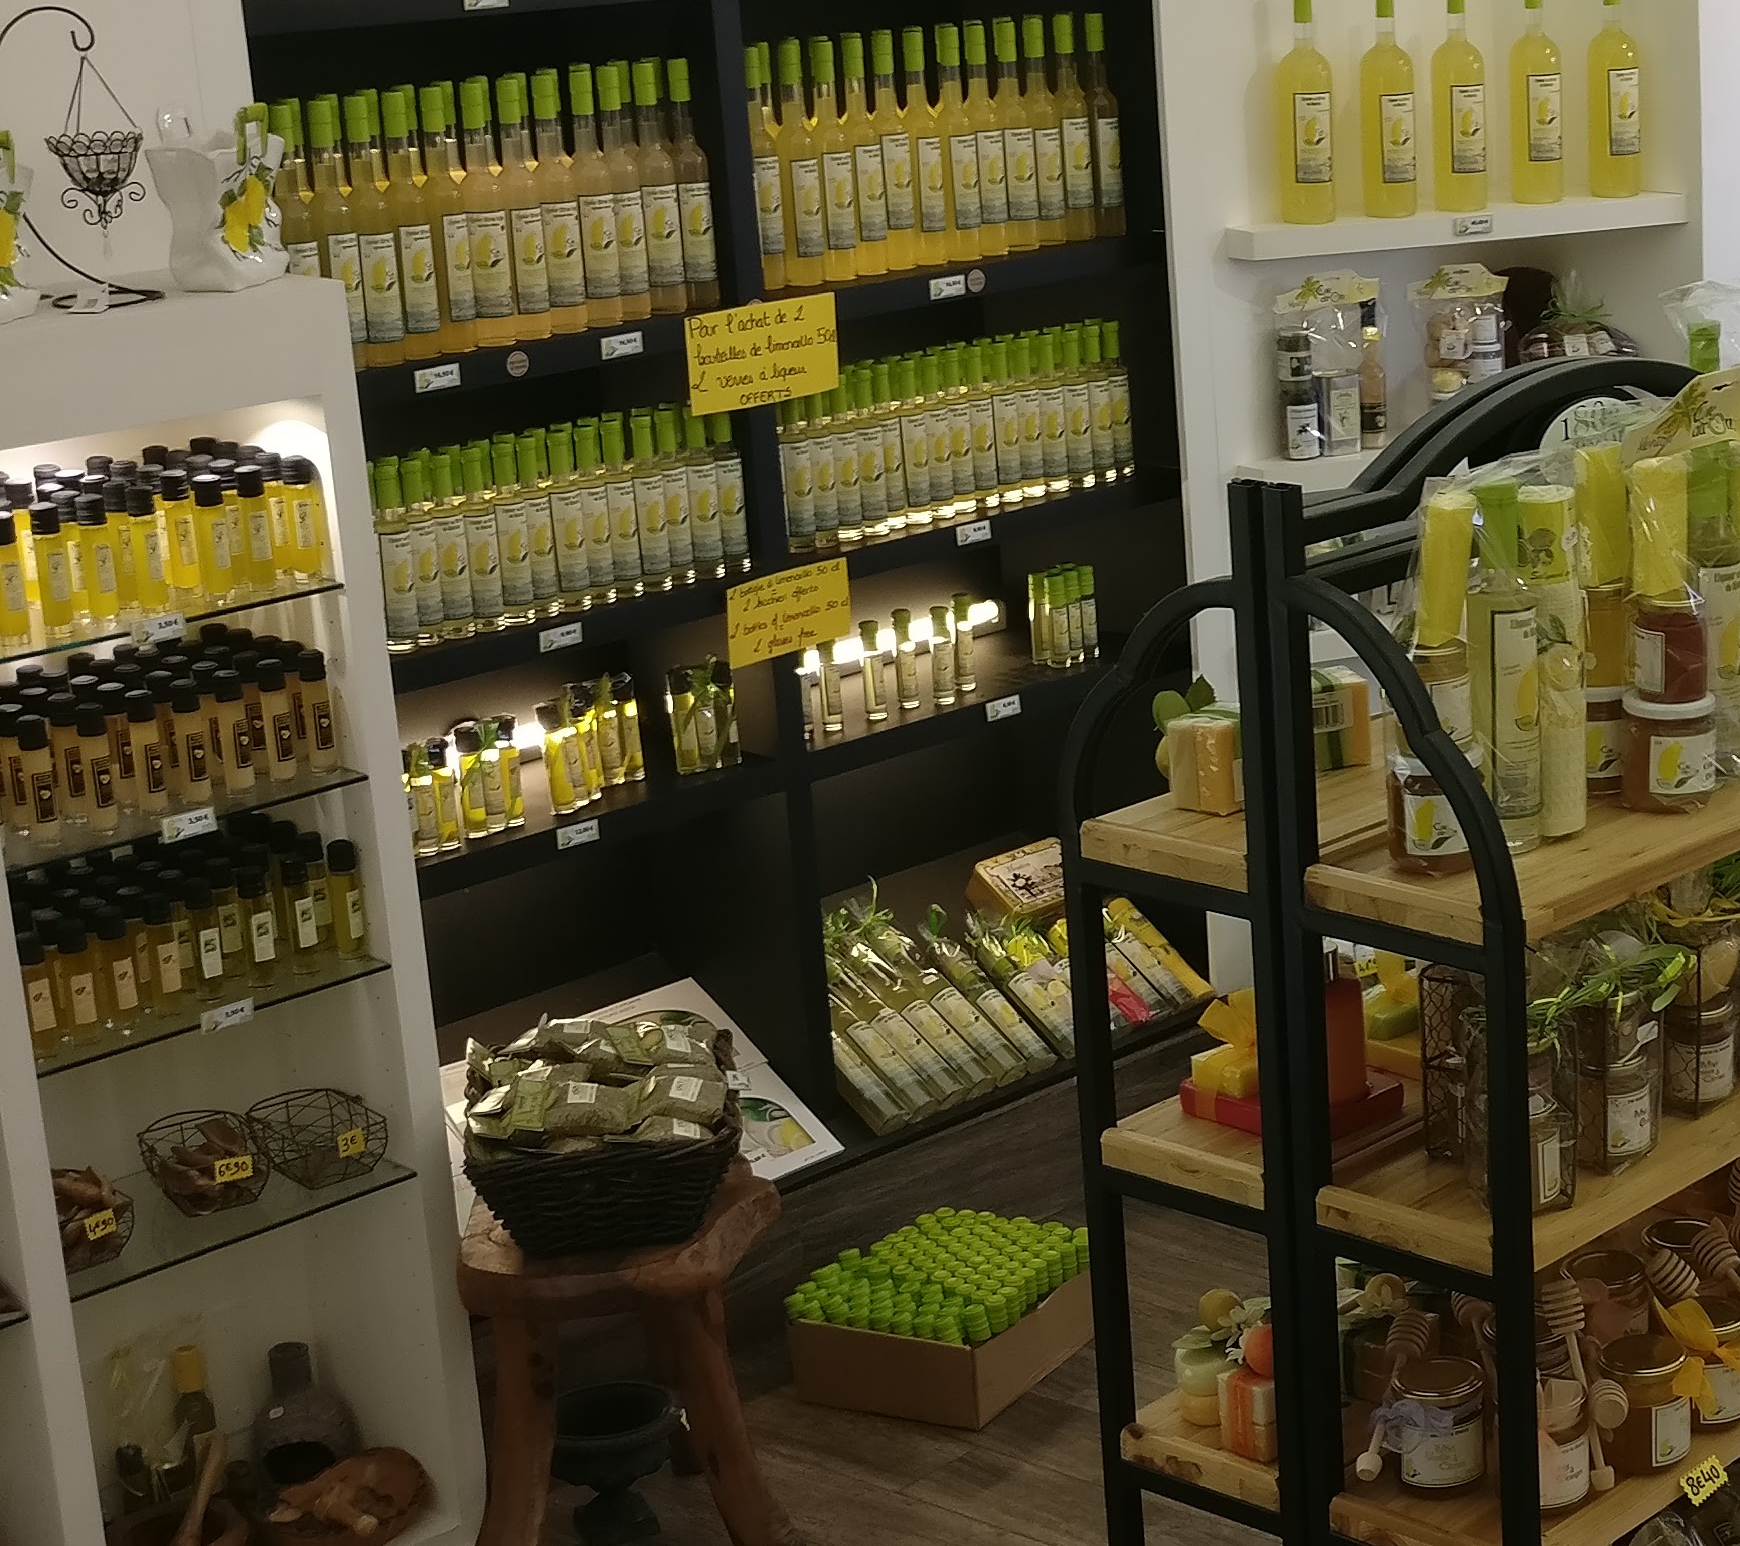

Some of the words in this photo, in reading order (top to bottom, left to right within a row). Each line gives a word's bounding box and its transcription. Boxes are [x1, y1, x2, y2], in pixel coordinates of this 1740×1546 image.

[774, 308, 787, 324] de
[794, 305, 805, 321] 2
[750, 342, 762, 357] de
[739, 386, 792, 405] OFFERTS
